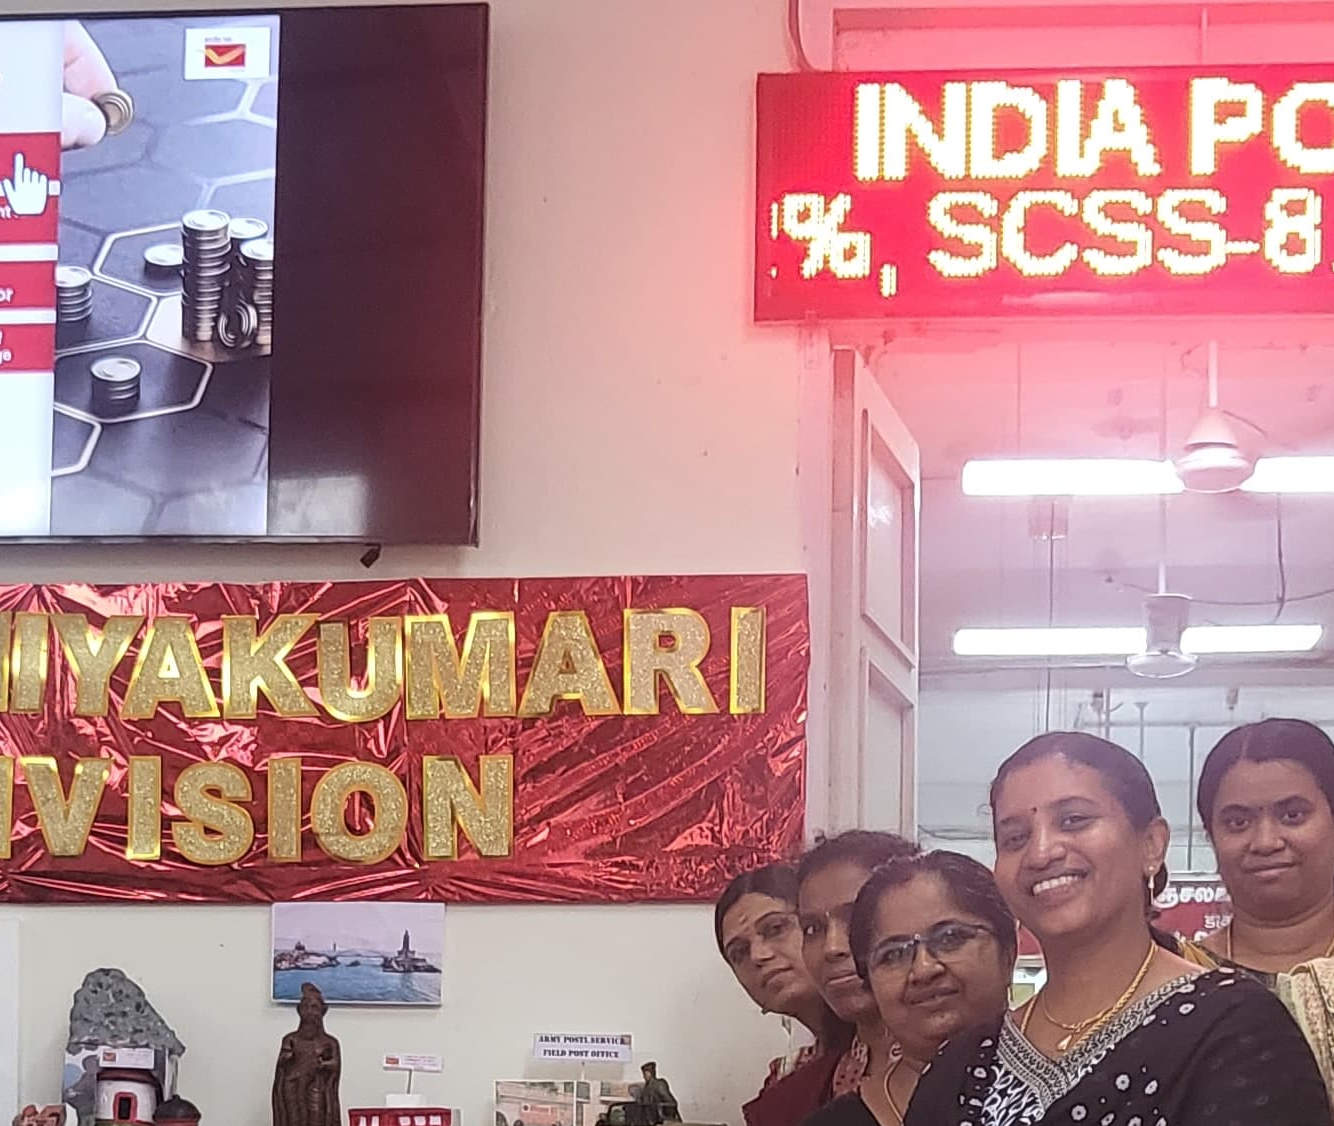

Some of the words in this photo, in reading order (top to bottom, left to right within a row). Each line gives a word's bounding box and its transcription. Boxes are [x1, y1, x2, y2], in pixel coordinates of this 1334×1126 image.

[853, 79, 1161, 182] INDIA
[543, 1048, 567, 1057] FIELD
[568, 1049, 589, 1058] POST
[590, 1050, 620, 1059] OFFICE
